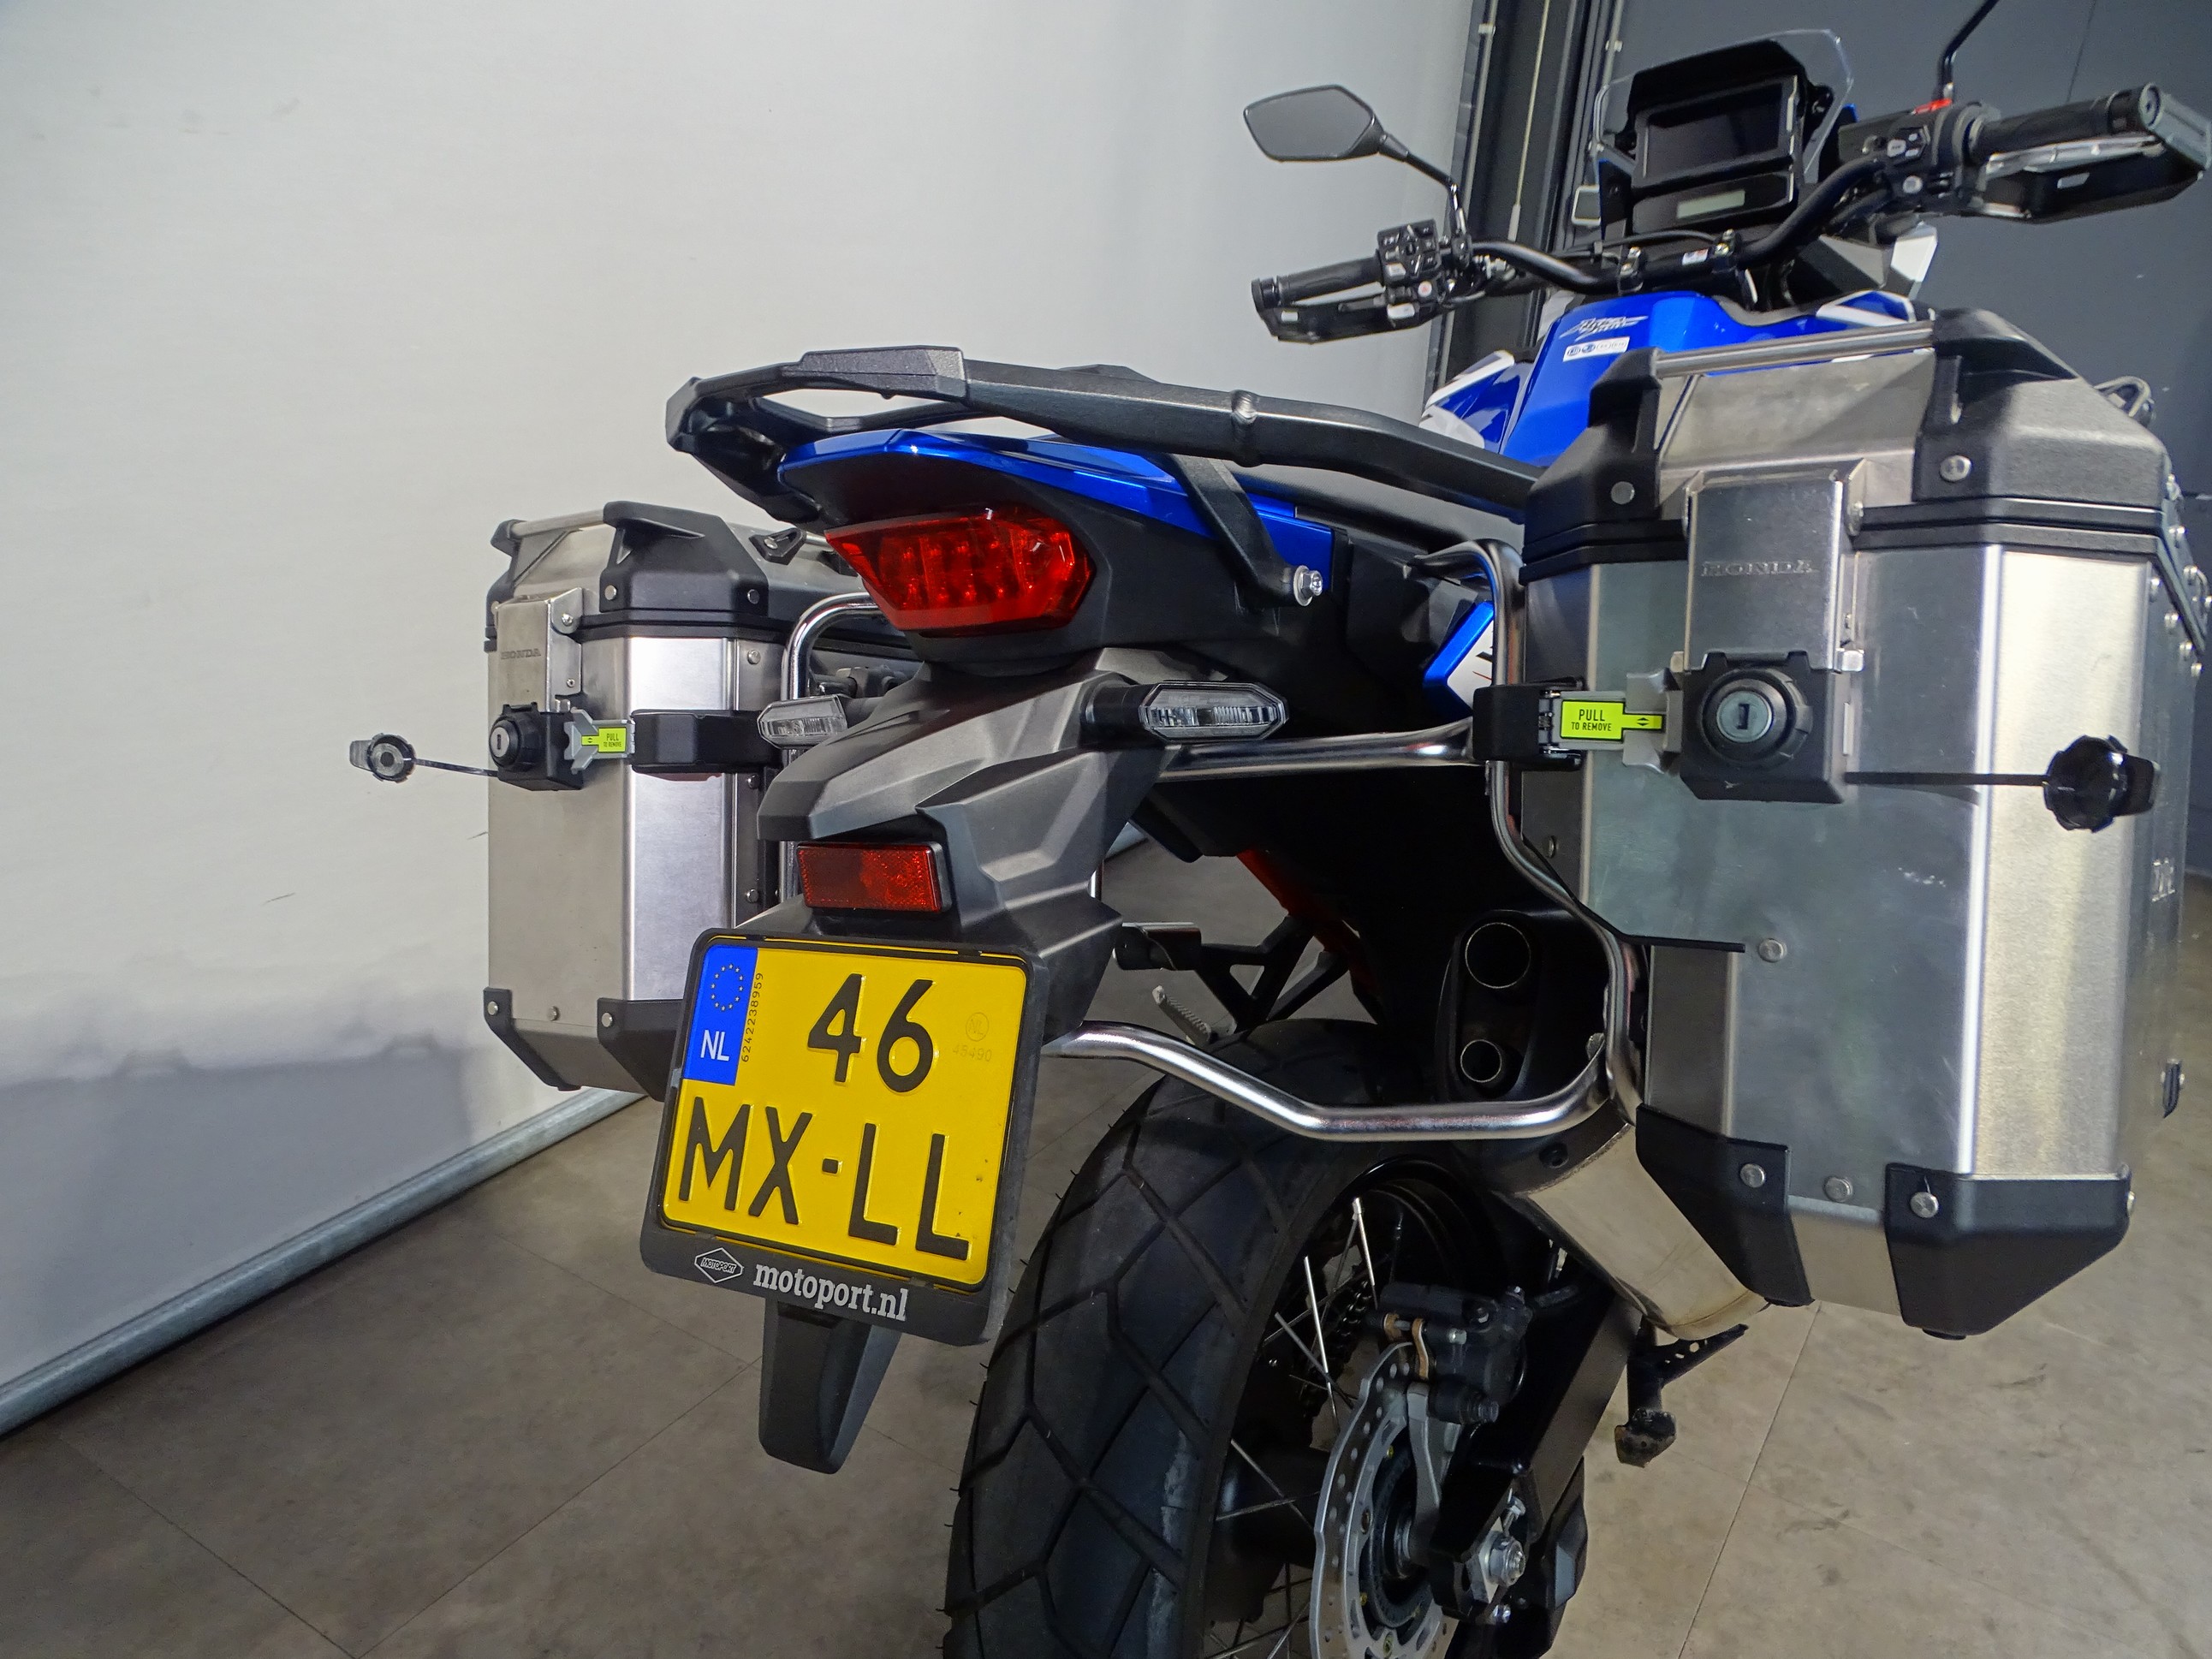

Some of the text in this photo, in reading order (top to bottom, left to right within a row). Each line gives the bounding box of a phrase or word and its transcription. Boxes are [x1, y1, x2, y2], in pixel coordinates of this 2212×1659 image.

[1701, 559, 1819, 577] HONDA
[1571, 722, 1612, 732] TO REMOVE
[1579, 709, 1605, 722] PULL
[741, 972, 764, 1062] 6242238959
[806, 972, 934, 1093] 46
[700, 1029, 729, 1061] NL
[678, 1097, 970, 1261] MX-LL
[700, 1257, 737, 1274] MOTOPORT
[753, 1264, 909, 1322] motoport.nl
